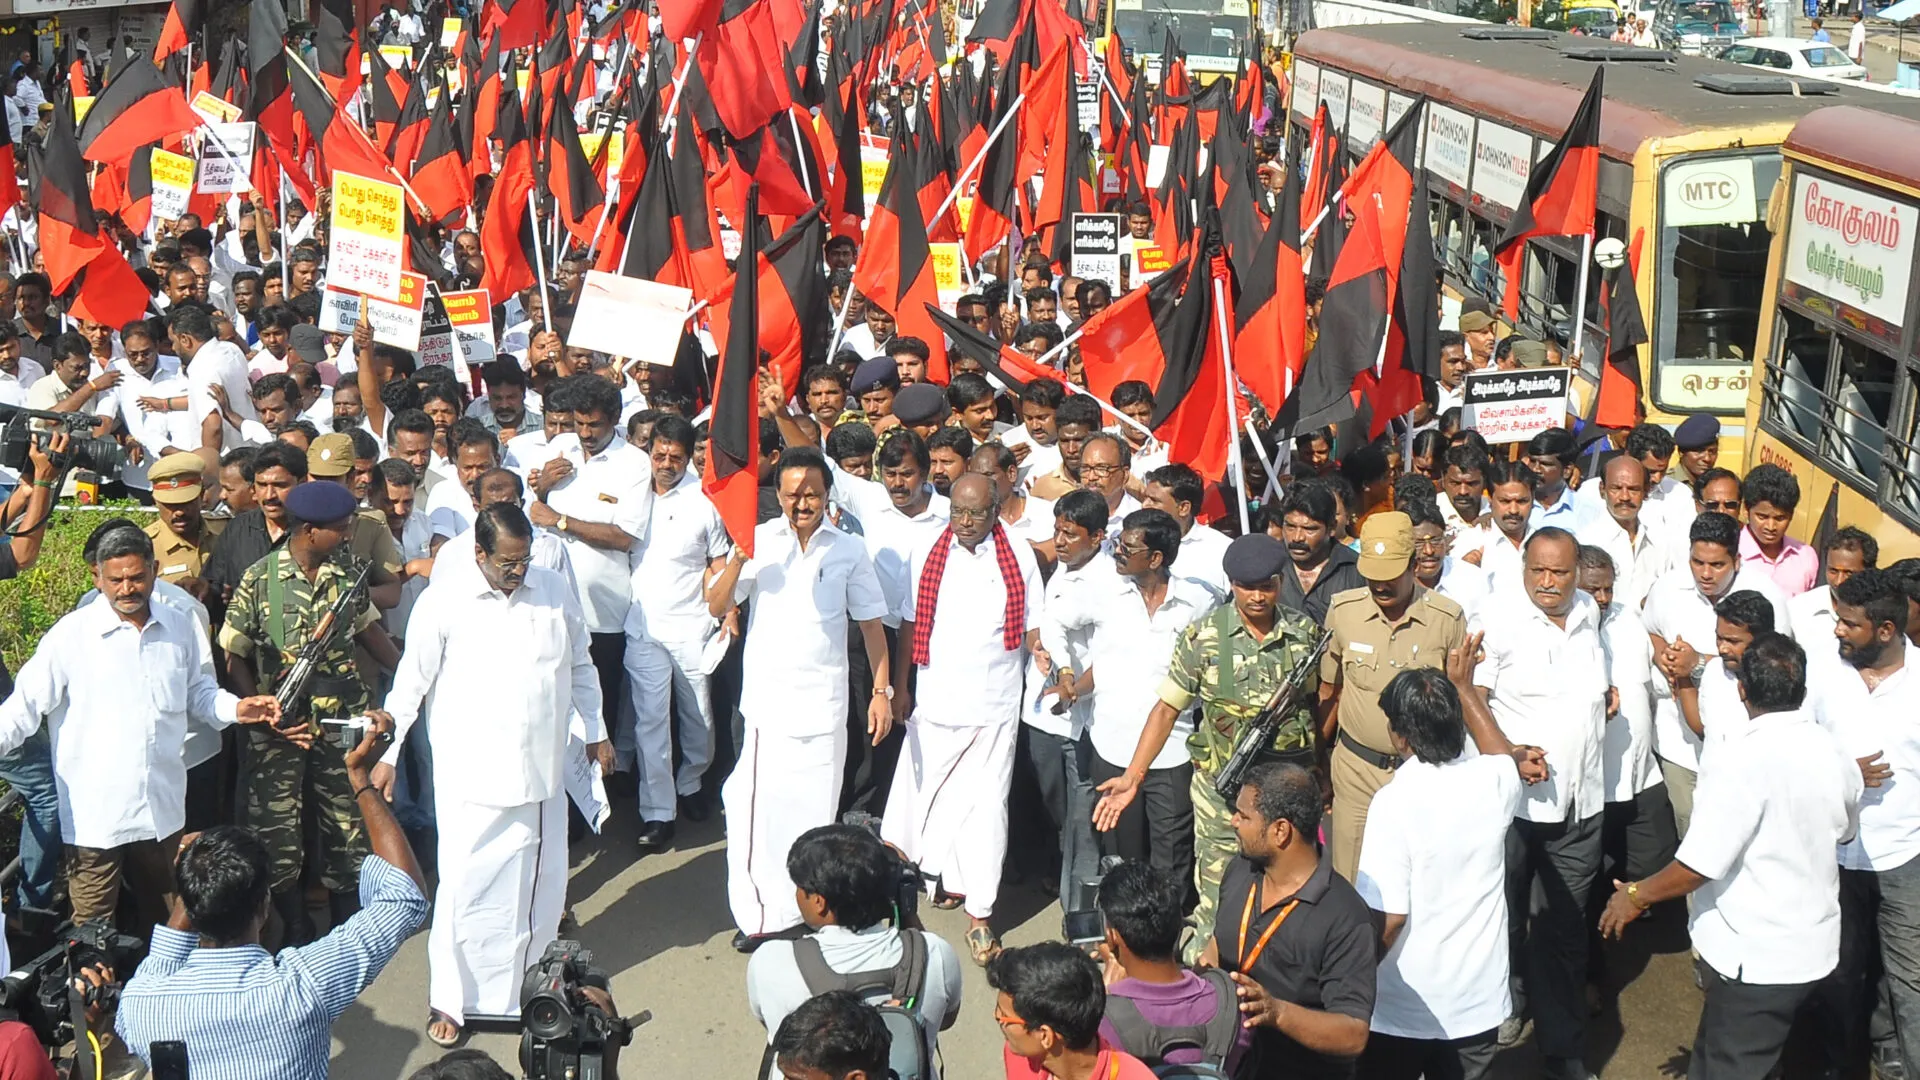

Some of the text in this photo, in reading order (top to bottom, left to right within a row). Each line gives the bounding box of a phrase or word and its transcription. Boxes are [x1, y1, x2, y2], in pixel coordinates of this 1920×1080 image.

[1436, 116, 1470, 147] JOHNSON
[203, 177, 234, 187] எரிக்கா
[1685, 181, 1732, 201] MTC
[340, 182, 397, 213] பொது சொத்து
[339, 203, 396, 234] பொது சொத்து
[1804, 182, 1900, 249] கோகுலம்
[1075, 218, 1116, 236] எரிக்காதே
[1075, 235, 1116, 252] எரிக்காதே
[328, 299, 358, 313] காவிரி
[1471, 375, 1561, 398] அடிக்காதே அடிக்காதே
[1480, 404, 1548, 419] விவசாயிகளின்
[1510, 417, 1559, 432] அடிக்காதே
